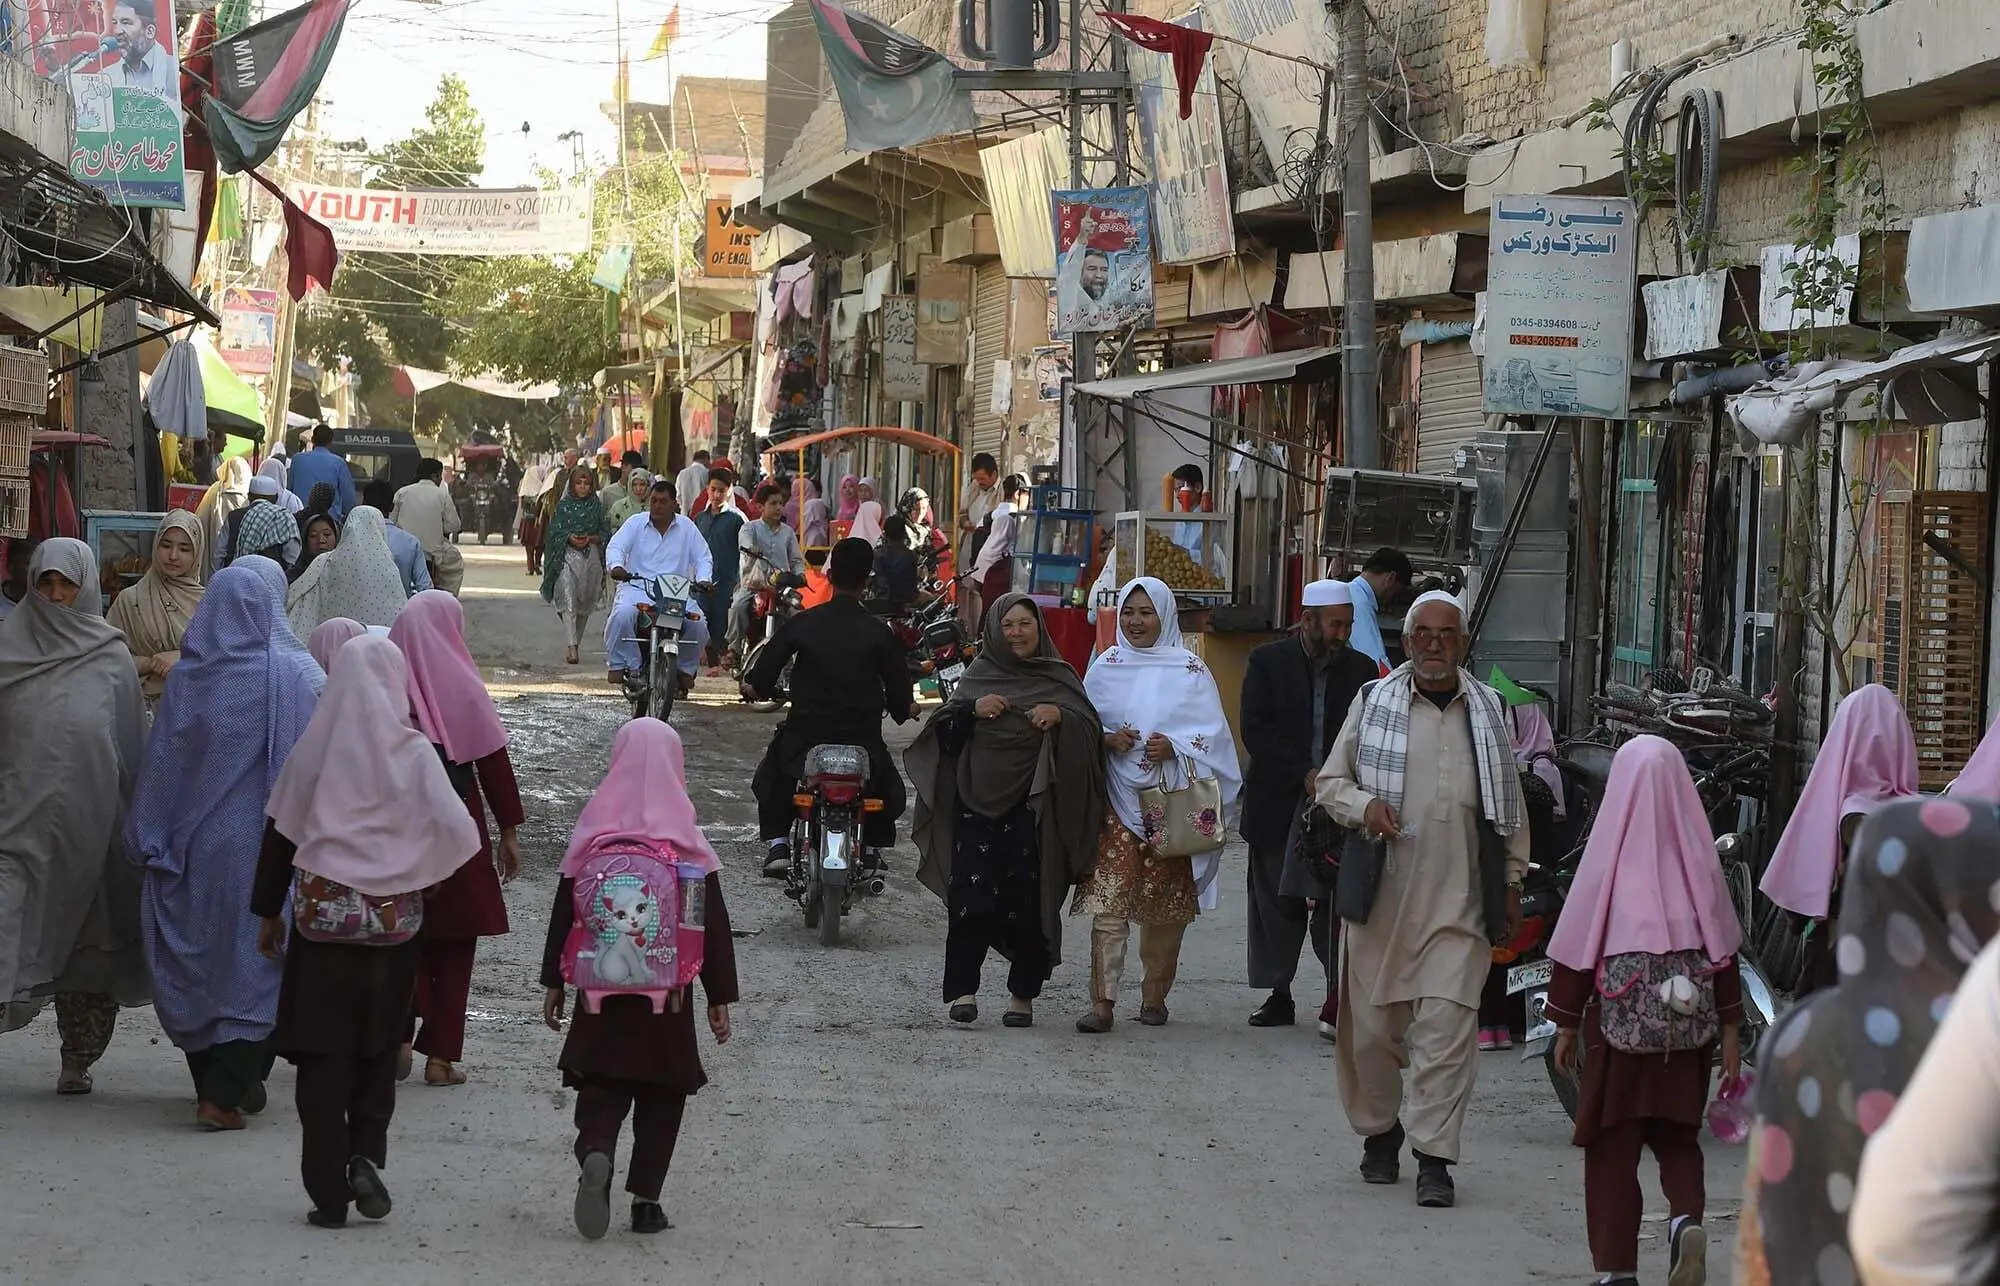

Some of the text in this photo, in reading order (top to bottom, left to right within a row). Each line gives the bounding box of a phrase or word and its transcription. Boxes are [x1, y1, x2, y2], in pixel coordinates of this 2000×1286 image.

[83, 140, 125, 177] خان
[119, 136, 160, 173] طاہر
[149, 140, 178, 173] محمد
[299, 189, 575, 225] YOUTH EDUCATIONAL SOCIETY
[1498, 200, 1624, 228] علی رضا
[711, 251, 725, 265] OF
[1510, 317, 1578, 329] 0345-8394608
[1508, 972, 1525, 988] MK
